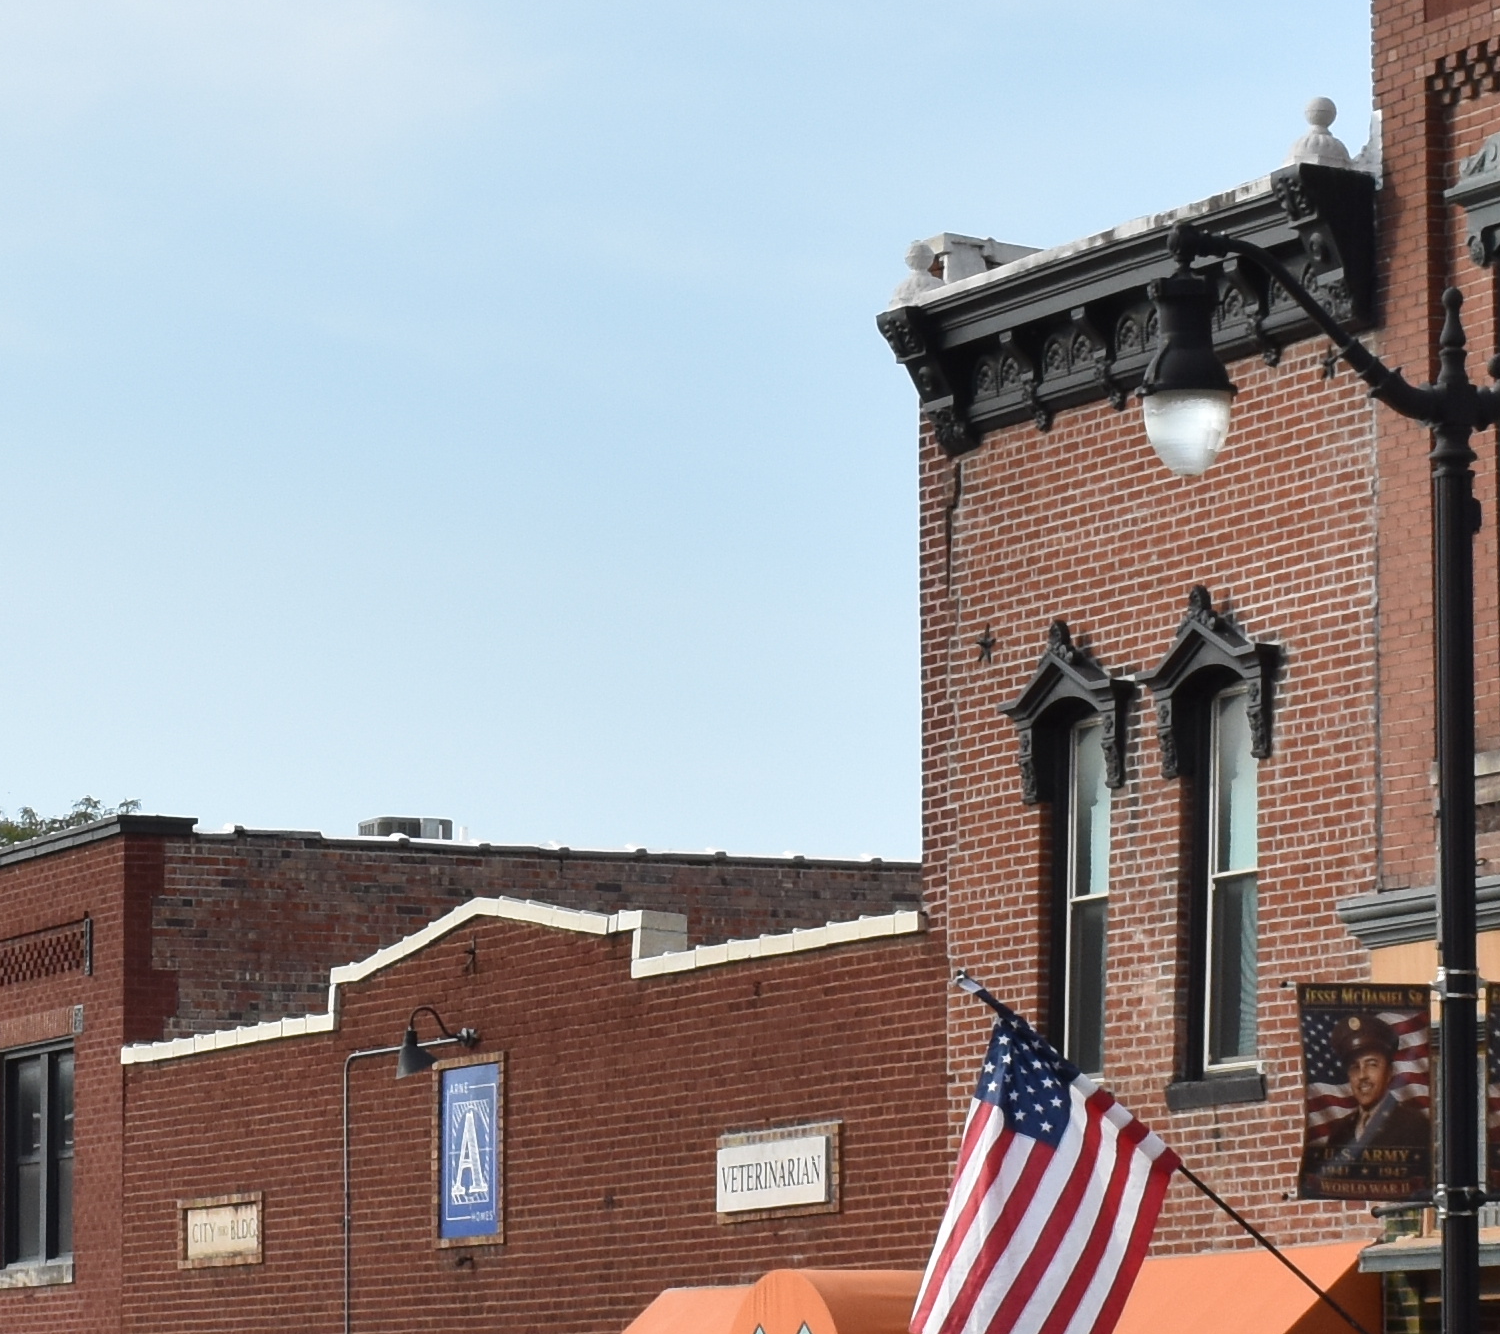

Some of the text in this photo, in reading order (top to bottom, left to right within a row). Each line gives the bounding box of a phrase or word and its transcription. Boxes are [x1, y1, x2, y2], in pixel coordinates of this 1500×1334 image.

[449, 1081, 469, 1095] ARNE
[1323, 1148, 1410, 1163] U.S. ARMY
[721, 1154, 821, 1194] VETERINARIAN
[1319, 1180, 1411, 1195] WORLD WAR II
[470, 1210, 494, 1222] HOMES
[192, 1222, 216, 1244] CITY
